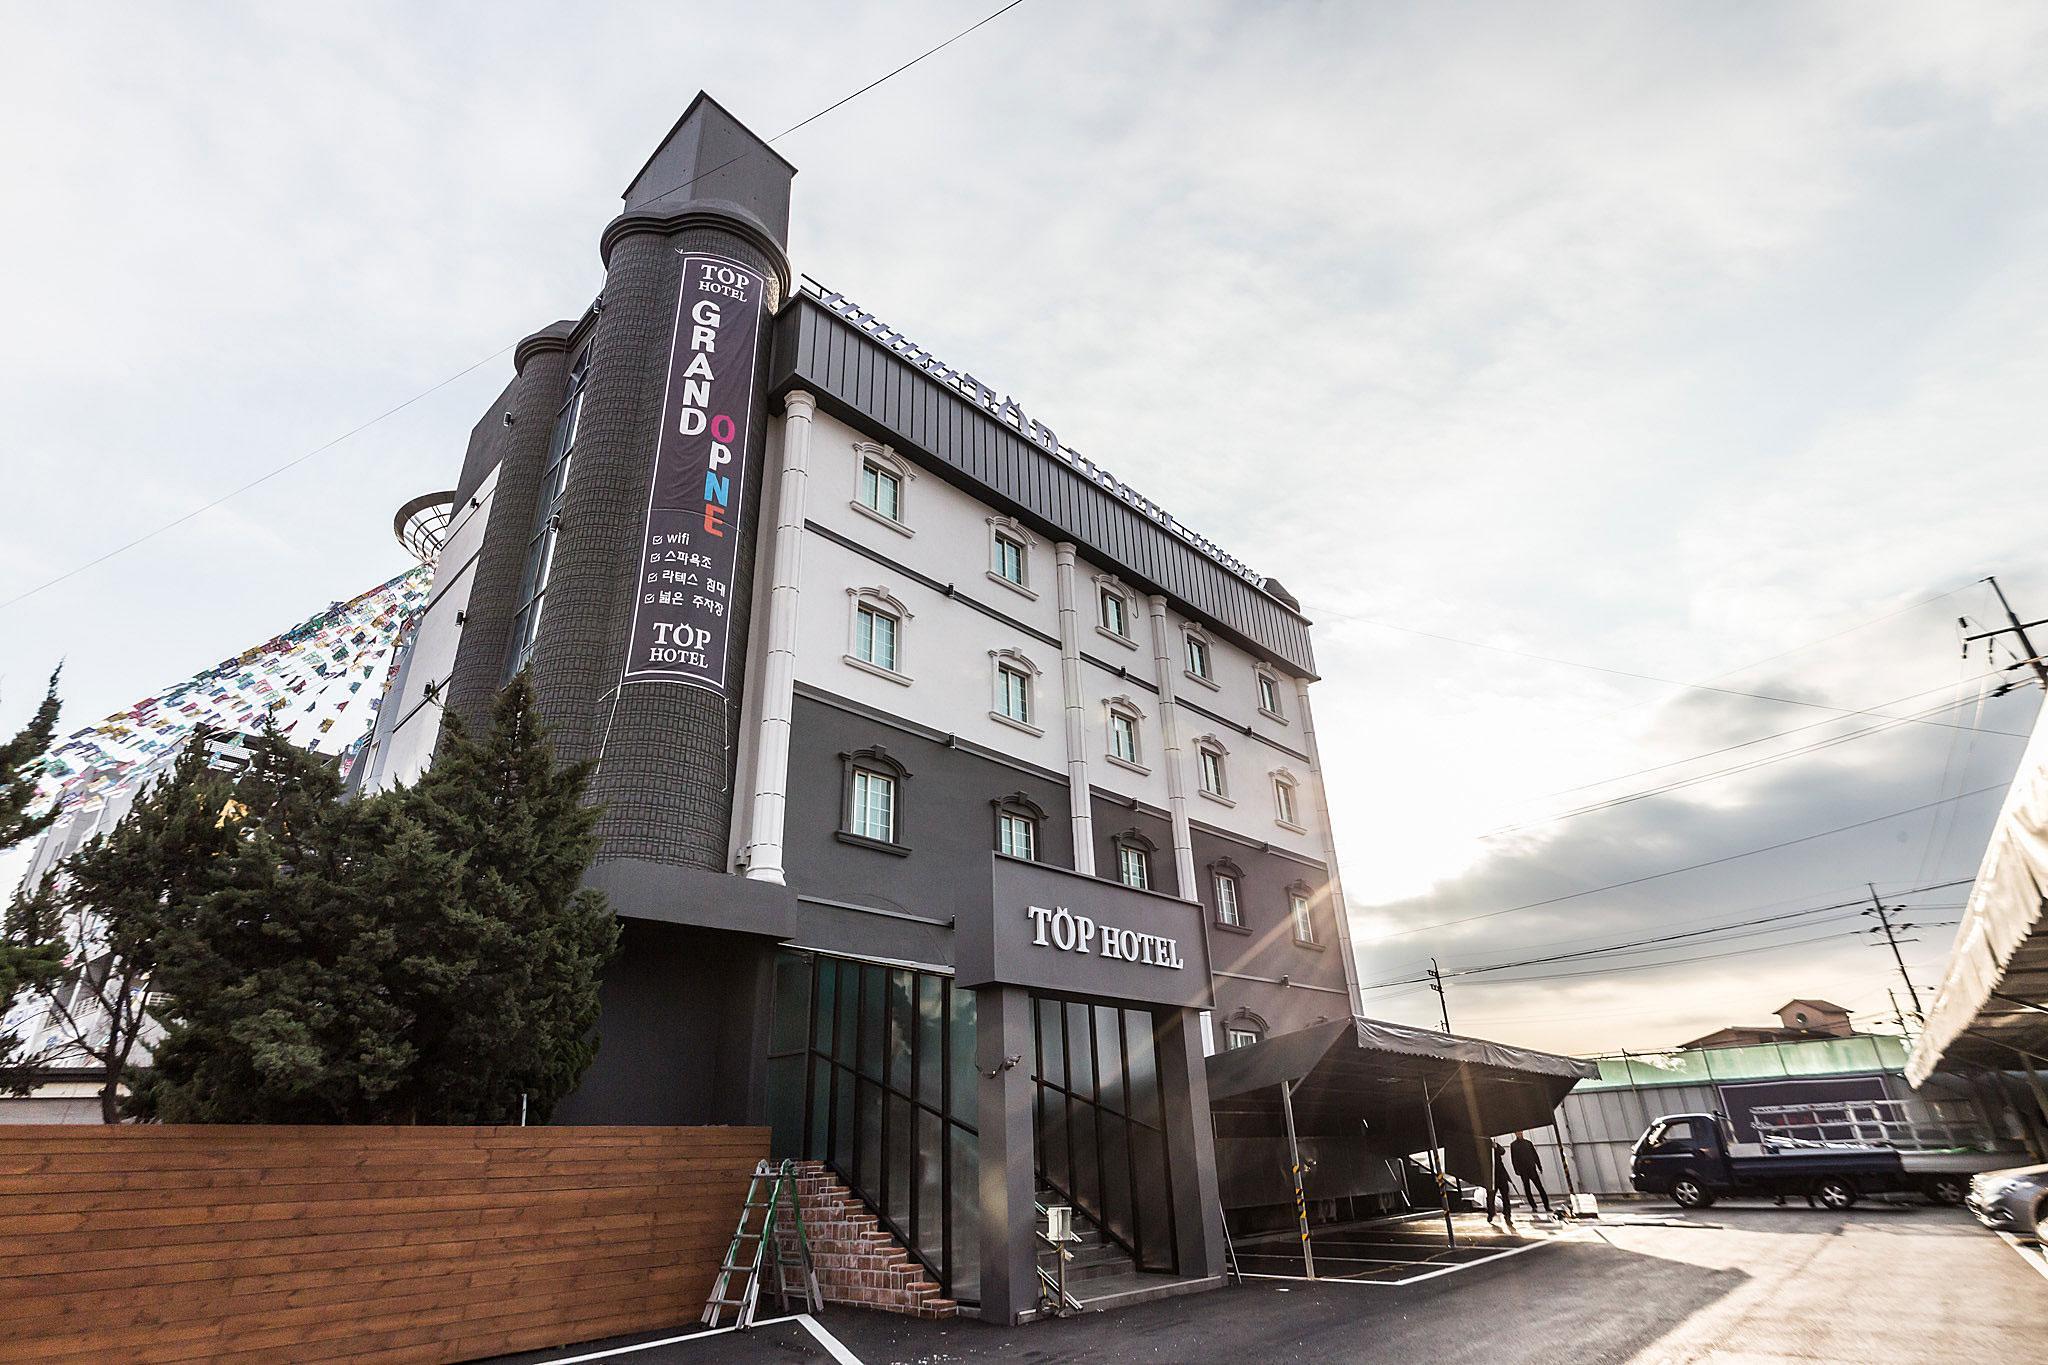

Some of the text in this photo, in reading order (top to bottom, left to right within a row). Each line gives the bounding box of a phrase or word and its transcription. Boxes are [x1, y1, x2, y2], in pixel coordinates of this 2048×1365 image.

[698, 281, 747, 302] HOTEL
[679, 300, 721, 436] GRAND
[667, 532, 690, 545] wifi
[664, 550, 712, 569] 스파욕조
[662, 570, 726, 598] 라텍스 침대
[659, 590, 724, 617] 넓은 주차장
[648, 647, 709, 669] HOTEL
[1027, 905, 1184, 970] TOP HOTEL
